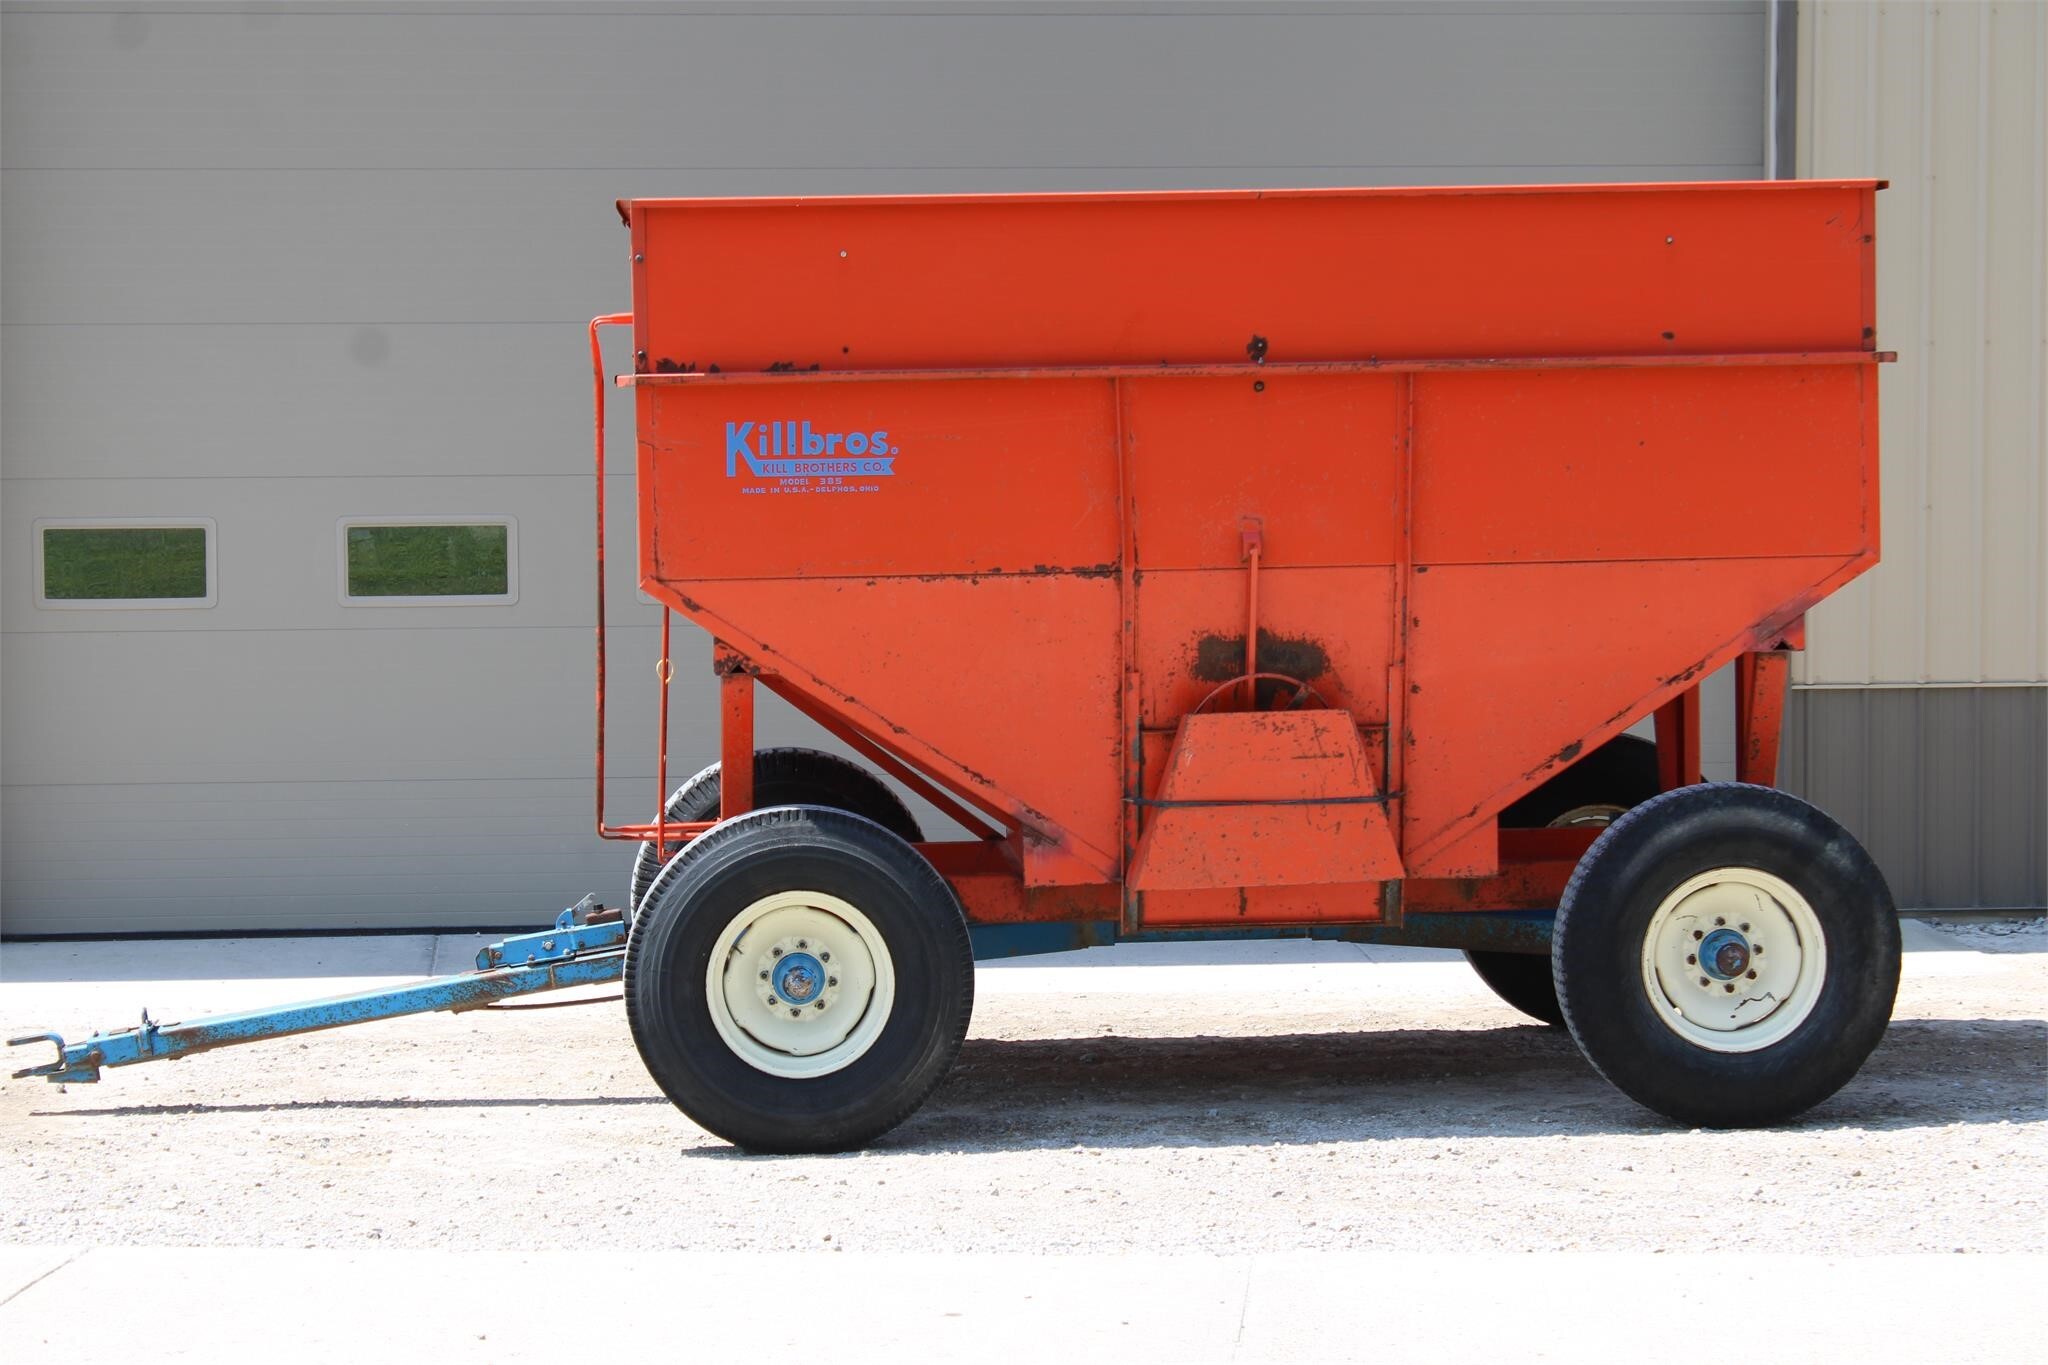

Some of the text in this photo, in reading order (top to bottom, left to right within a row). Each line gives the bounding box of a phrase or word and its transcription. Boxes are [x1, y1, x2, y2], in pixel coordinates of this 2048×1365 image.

[762, 461, 886, 474] KILL BROTHERS CO.
[780, 478, 809, 486] MODEL
